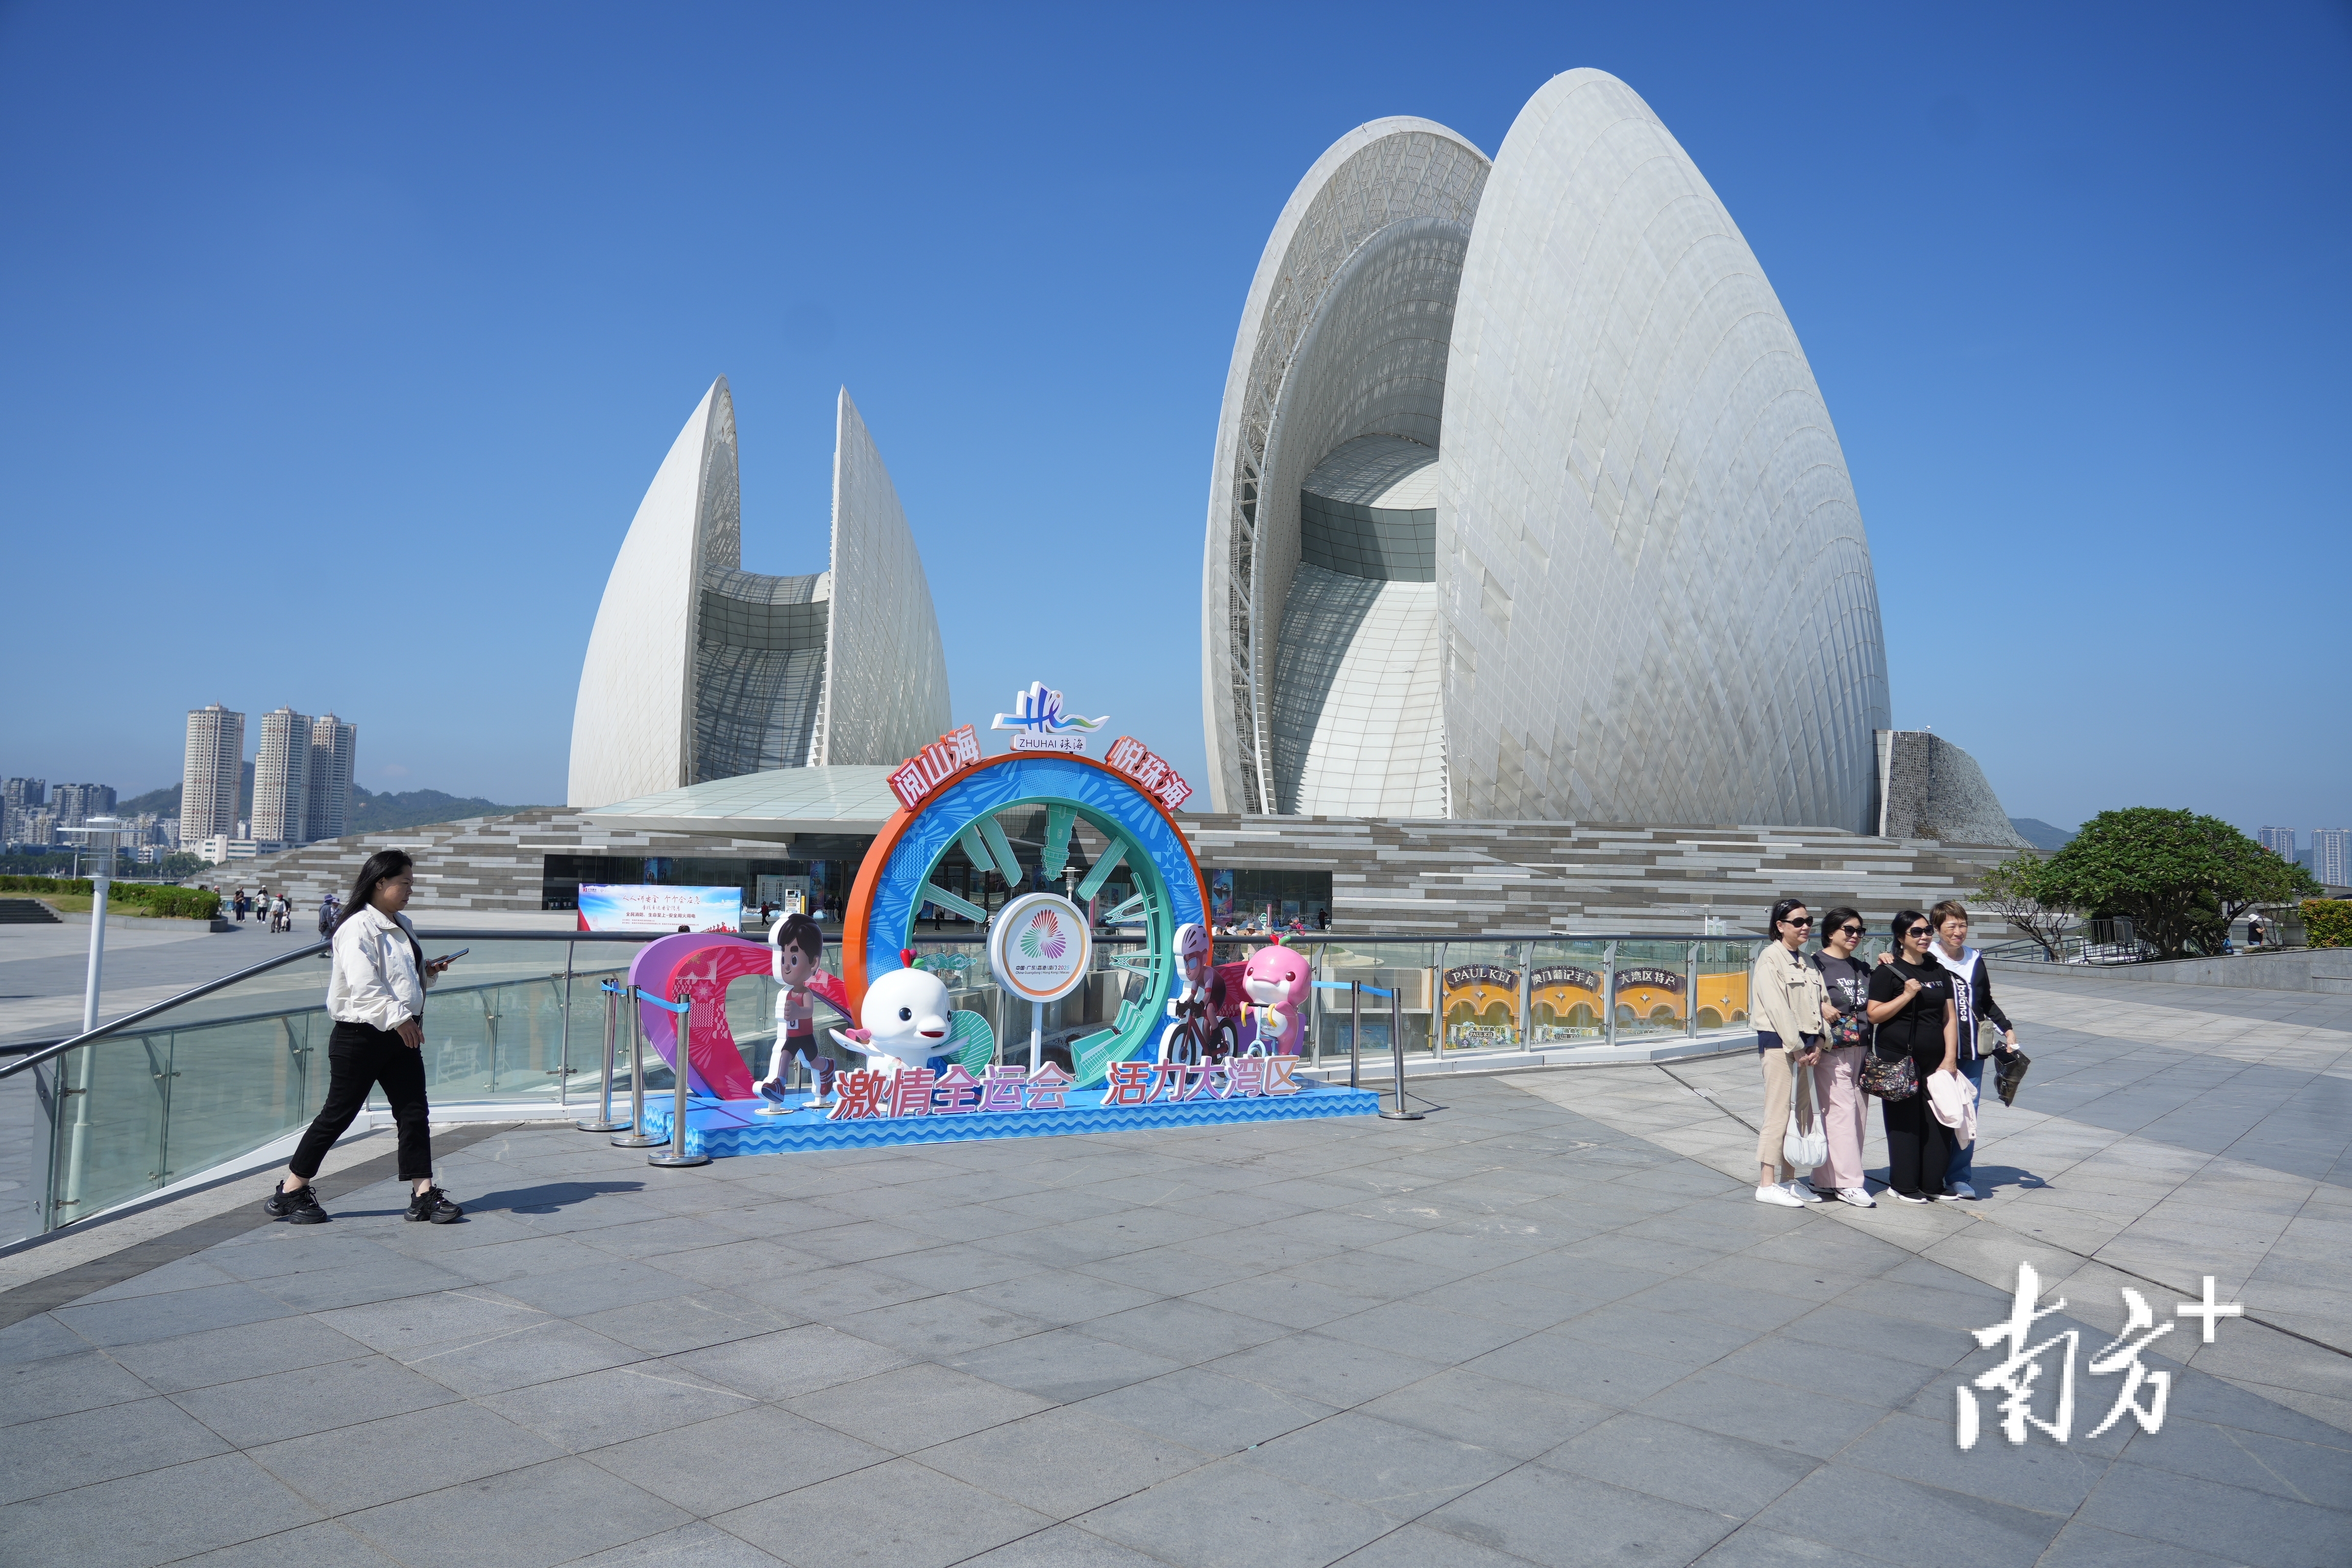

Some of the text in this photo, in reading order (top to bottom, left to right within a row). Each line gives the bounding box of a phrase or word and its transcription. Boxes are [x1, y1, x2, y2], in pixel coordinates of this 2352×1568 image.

[1019, 738, 1083, 750] ZHUHAI 珠海
[892, 726, 981, 810] 阅山海
[1112, 738, 1191, 811] 悦珠海
[622, 895, 659, 903] 人人讲安全
[1452, 968, 1511, 984] PAUL KEI
[1531, 969, 1595, 987] 澳门葡记手信
[1619, 970, 1676, 986] 大湾区特产
[827, 1055, 1300, 1119] 激情全运会 活力大湾区
